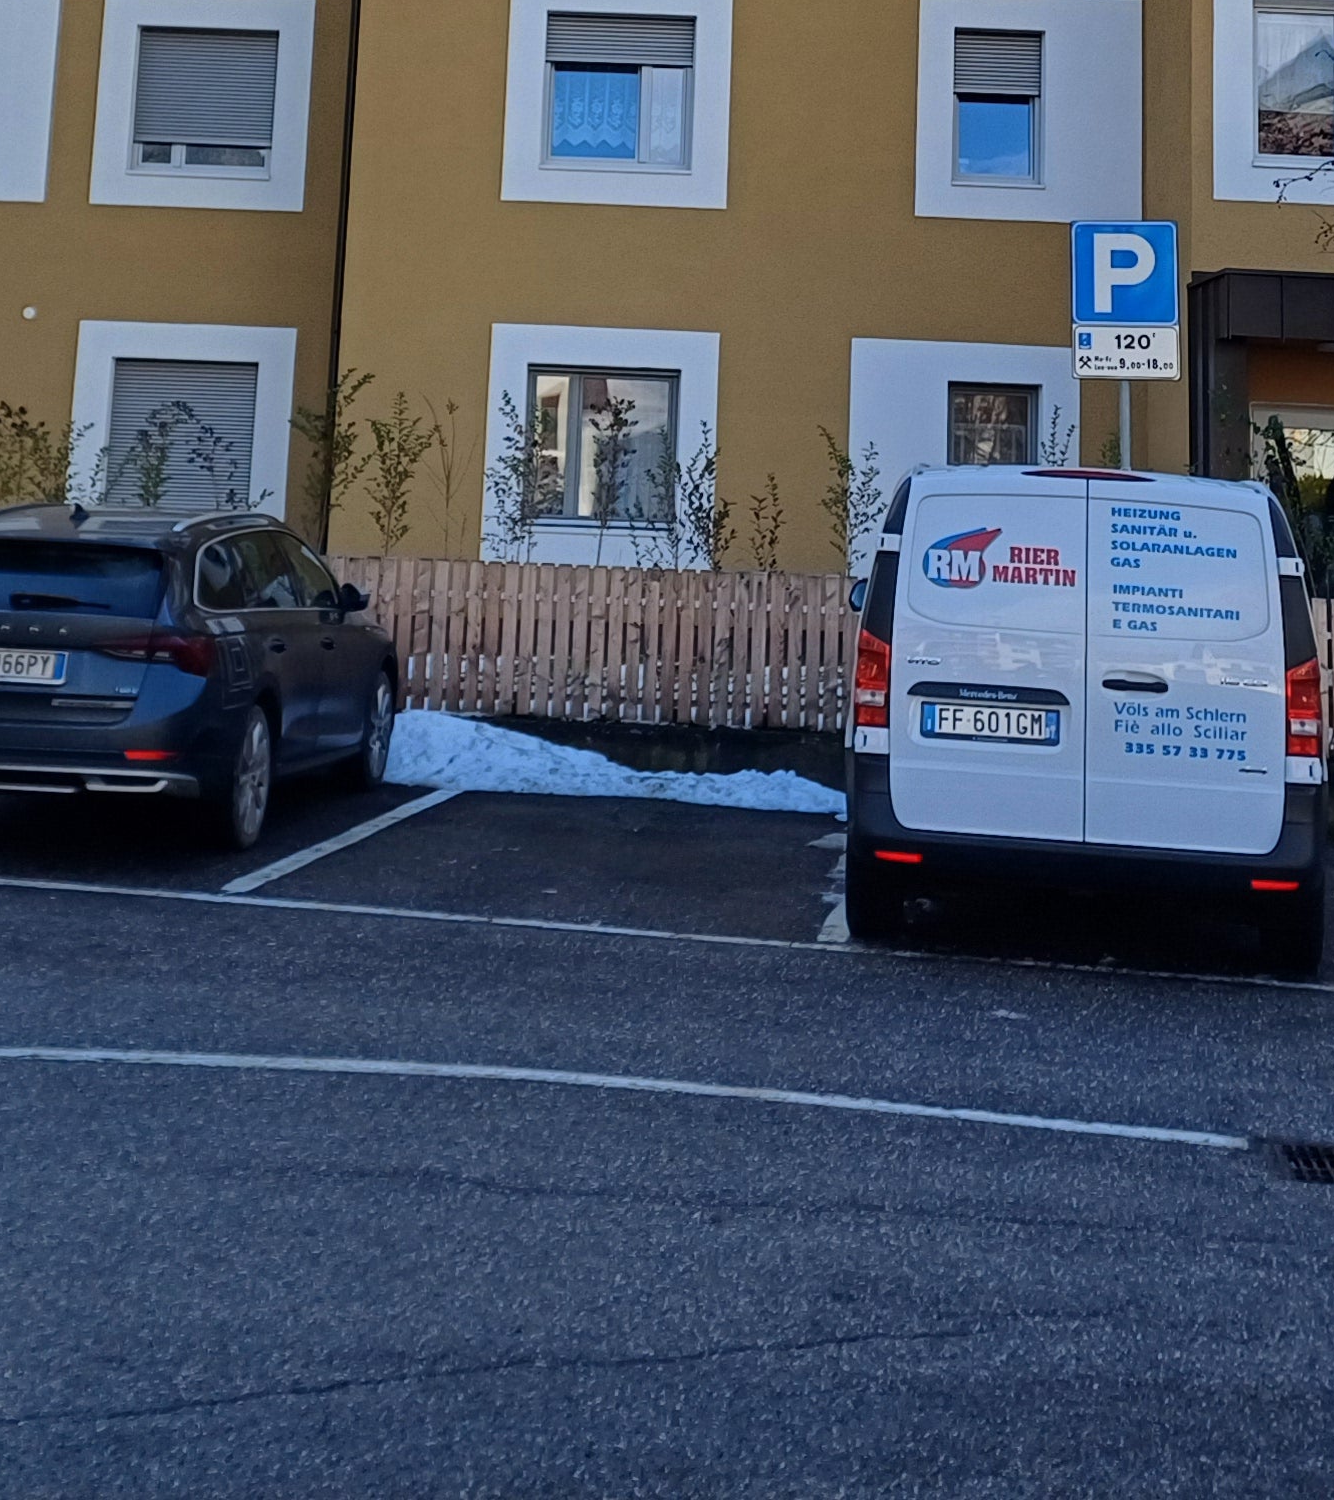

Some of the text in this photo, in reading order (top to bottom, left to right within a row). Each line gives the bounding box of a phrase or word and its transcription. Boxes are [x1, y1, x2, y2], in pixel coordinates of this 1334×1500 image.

[1094, 233, 1156, 313] P
[1111, 507, 1181, 521] HEIZUNG
[1110, 523, 1197, 539] SANITÄR u.
[1009, 546, 1060, 566] RIER
[1110, 540, 1237, 559] SOLARANLAGEN
[927, 548, 982, 582] RM
[1110, 557, 1141, 569] GAS
[992, 565, 1076, 587] MARTIN
[1113, 584, 1183, 599] IMPIANTI
[1112, 601, 1240, 621] TERMOSANITARI
[1113, 619, 1158, 632] E GAS
[938, 707, 964, 731] FF
[973, 710, 1043, 736] 601GM
[1114, 702, 1247, 724] Völs am Schlern
[1114, 719, 1248, 741] Fiè allo Sciliar
[1124, 741, 1247, 761] 335 57 33 775
